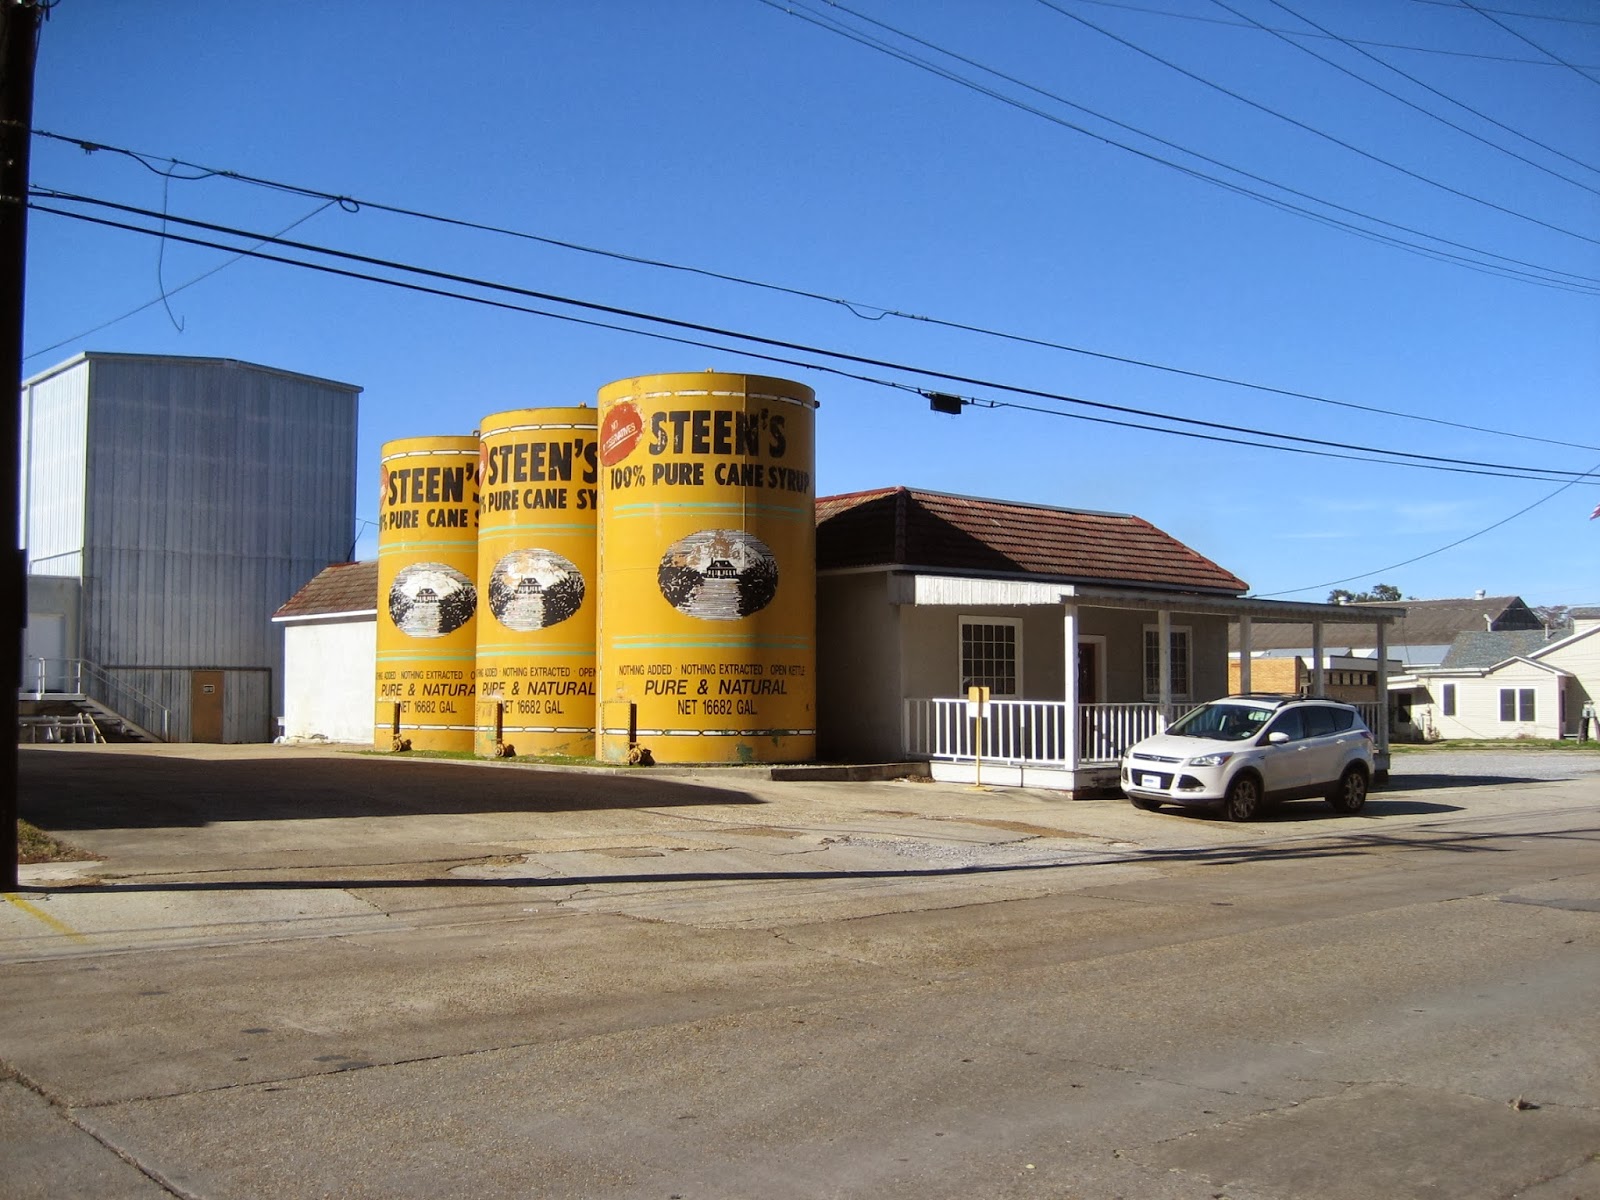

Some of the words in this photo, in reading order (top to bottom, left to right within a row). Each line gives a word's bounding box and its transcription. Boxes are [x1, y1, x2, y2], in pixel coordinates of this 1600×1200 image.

[649, 408, 787, 458] STEEN'S
[488, 438, 598, 485] STEEN'S
[610, 465, 646, 490] 100%
[652, 463, 705, 486] PURE
[714, 463, 764, 487] CANE
[768, 467, 810, 494] SYRUP
[488, 489, 519, 513] PURE
[523, 488, 567, 510] CANE
[389, 509, 420, 530] PURE
[426, 508, 469, 528] CANE
[400, 670, 424, 680] NOTHING
[426, 670, 464, 680] EXTRACTED
[502, 666, 528, 678] NOTHING
[530, 666, 571, 677] EXTRACTED
[619, 664, 645, 676] NOTHING
[647, 664, 672, 676] ADDED
[681, 663, 716, 676] NOTHING
[719, 663, 763, 676] EXTRACTED
[770, 664, 787, 676] OPEN
[381, 683, 403, 697] PURE
[407, 682, 416, 697] &
[511, 681, 520, 696] &
[527, 681, 597, 696] NATURAL
[644, 679, 689, 696] PURE
[697, 678, 709, 696] &
[718, 679, 788, 696] NATURAL
[414, 700, 436, 714] 16682
[439, 700, 458, 714] GAL.
[517, 699, 541, 715] 16682
[544, 700, 565, 715] GAL.
[677, 699, 698, 716] NET
[702, 699, 733, 716] 16682
